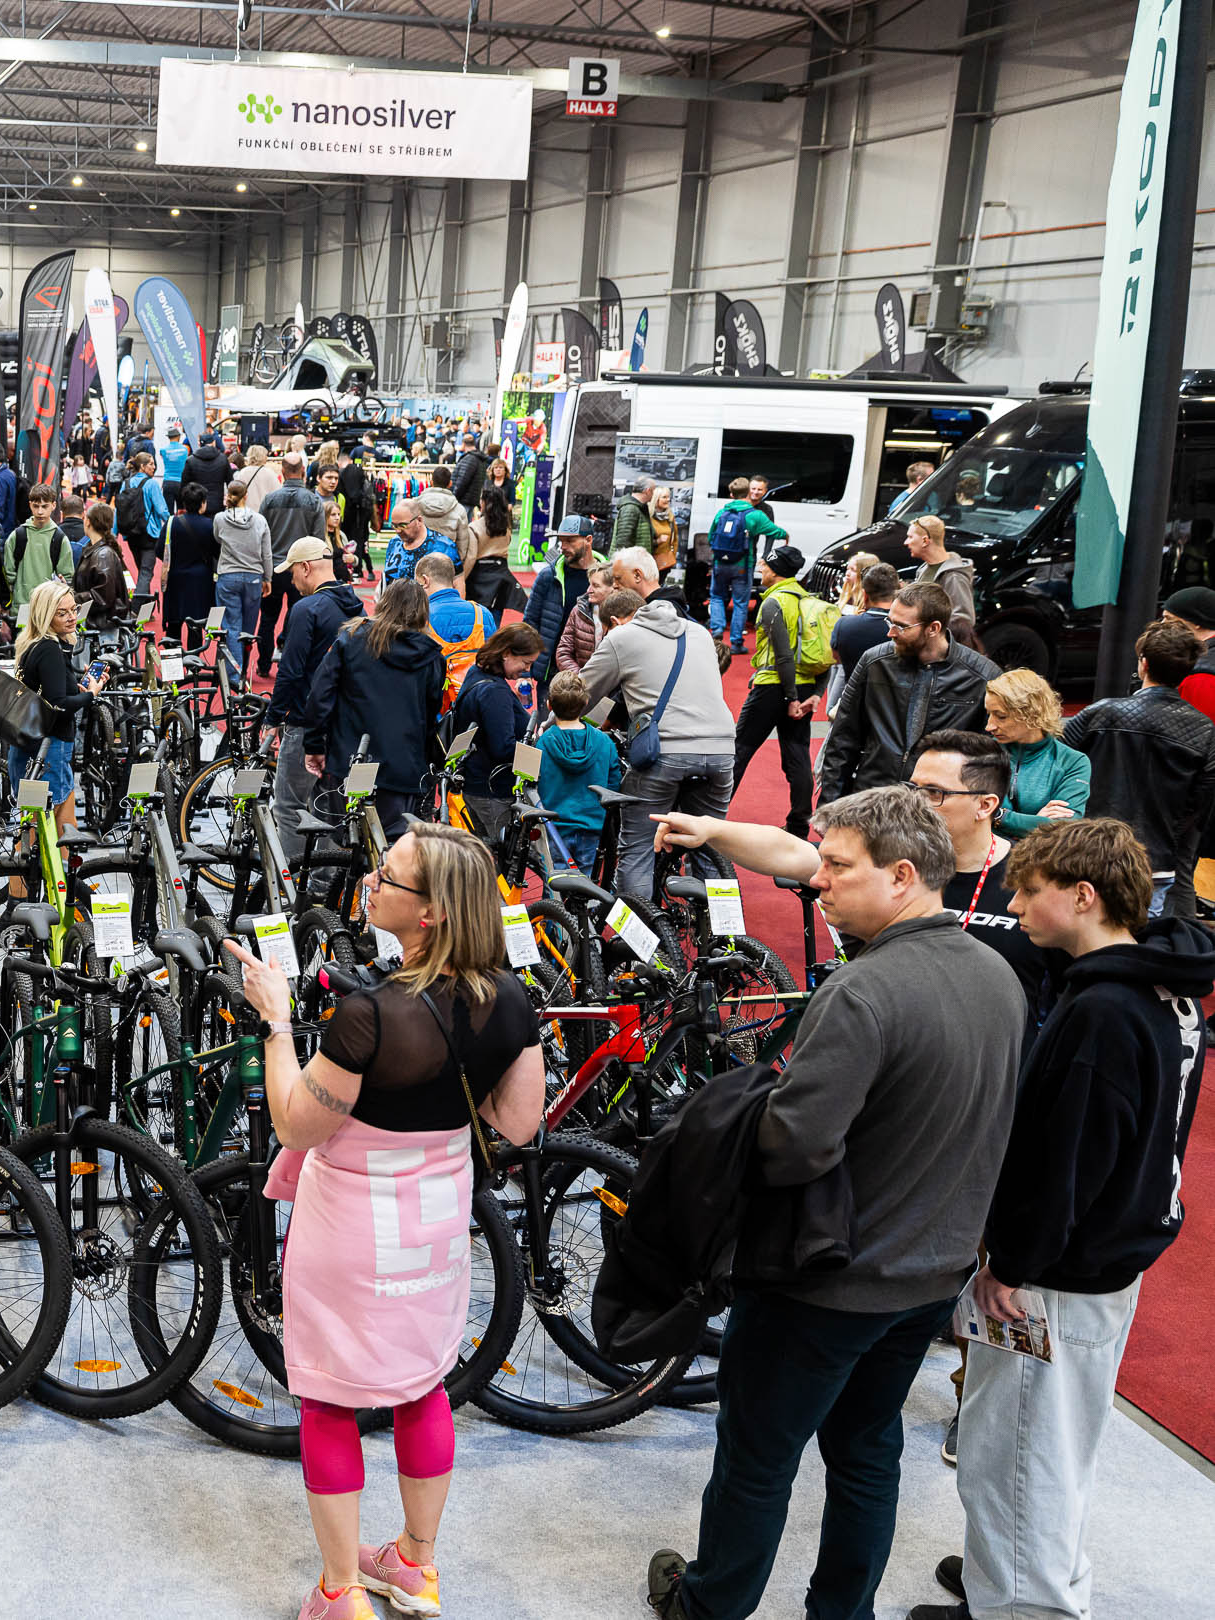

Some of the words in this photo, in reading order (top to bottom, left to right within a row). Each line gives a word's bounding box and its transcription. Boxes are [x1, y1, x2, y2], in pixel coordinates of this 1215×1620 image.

[582, 63, 607, 96] B
[292, 98, 457, 131] nanosilver
[569, 101, 603, 115] HALA
[605, 102, 616, 115] 2
[238, 137, 294, 151] FUNKČNÍ
[300, 139, 363, 154] OBLEČENÍ
[369, 145, 383, 155] SE
[389, 144, 453, 157] STŘÍBREM
[537, 351, 553, 362] HALA
[190, 1263, 204, 1338] MAXXIS
